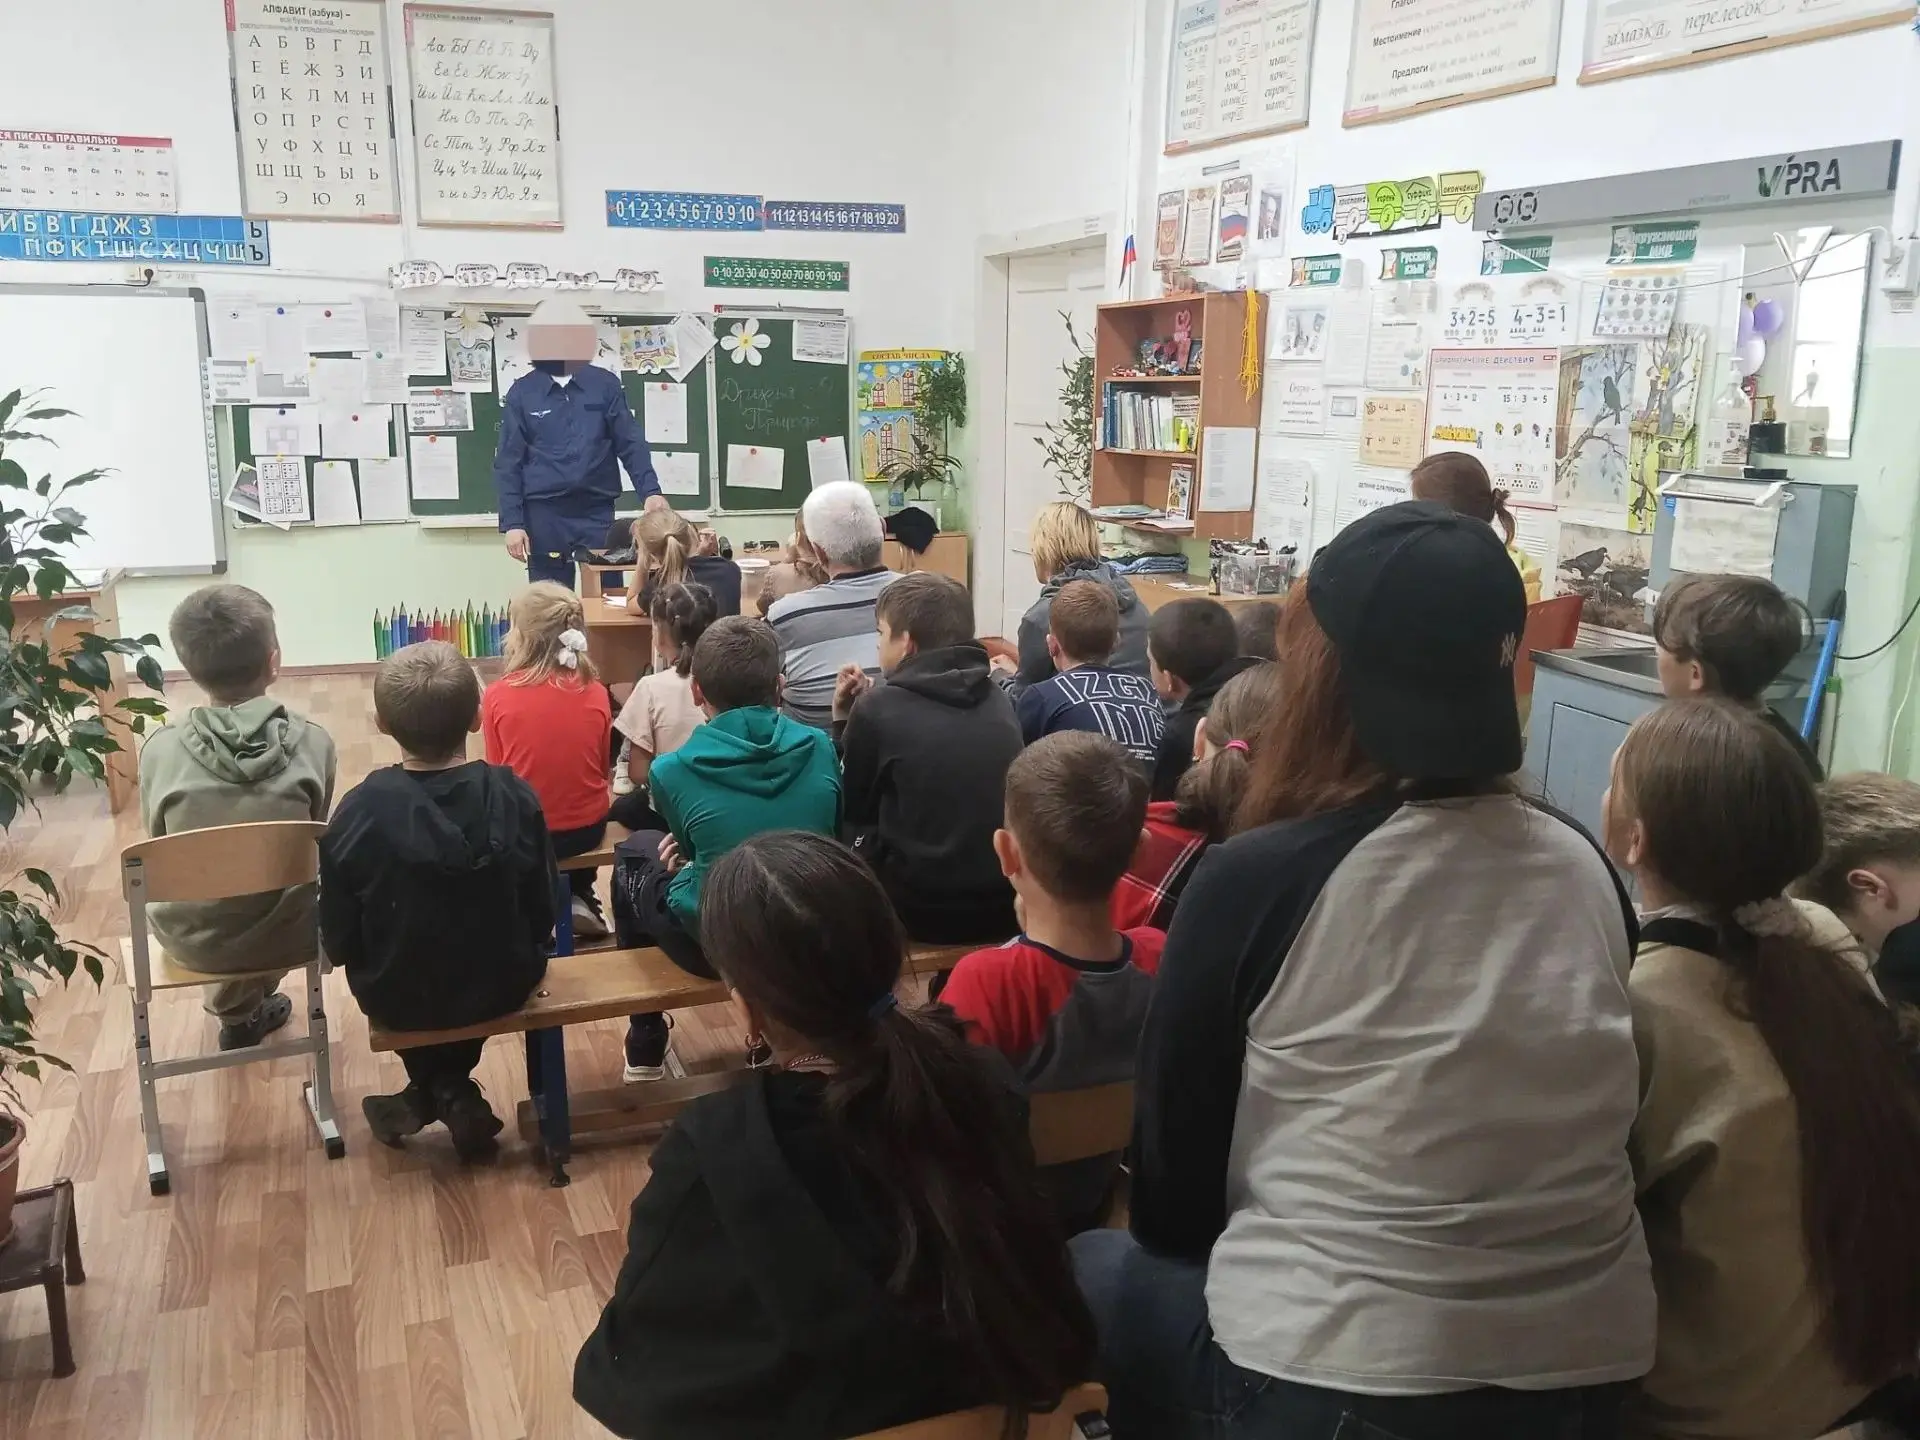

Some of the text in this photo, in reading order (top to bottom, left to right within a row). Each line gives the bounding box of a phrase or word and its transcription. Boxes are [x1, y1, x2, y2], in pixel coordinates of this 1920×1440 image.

[262, 4, 343, 19] АЛФАВИТ (азбука)
[249, 35, 372, 55] А Б В Г Д
[424, 37, 446, 53] Аа
[1372, 28, 1422, 47] Местоимение
[252, 59, 373, 79] Е Ё Ж З И
[1391, 63, 1428, 80] Предлоги
[252, 84, 374, 104] Й К Л М Н
[254, 112, 375, 129] О П Р С Т
[13, 132, 53, 142] ПИСАТЬ
[56, 134, 118, 145] ПРАВИЛЬНО
[257, 138, 377, 156] У Ф Х Ц Ч
[424, 133, 439, 148] Сс
[522, 138, 547, 152] Хх
[256, 164, 379, 180] Ш Щ Ъ Ы Ь
[433, 159, 456, 176] Цц
[480, 160, 508, 176] Шш
[512, 162, 542, 180] Щщ
[276, 191, 365, 206] Э Ю Я
[492, 186, 515, 200] Юю
[519, 186, 541, 200] Яя
[616, 201, 754, 221] 0 1 2 3 4 5 6 7 8 9 10
[772, 209, 899, 225] 11 12 13 14 15 16 17 18 19 20
[24, 214, 38, 232] Б
[47, 215, 60, 233] В
[70, 216, 86, 233] Г
[90, 216, 108, 236] Д
[112, 216, 133, 235] Ж
[138, 218, 151, 235] З
[251, 221, 262, 238] Ь
[24, 239, 263, 262] П Ф К Т Ш С Х Ц Ч Щ Ъ
[713, 267, 841, 281] 0 10 20 30 40 50 60 70 80 90 100
